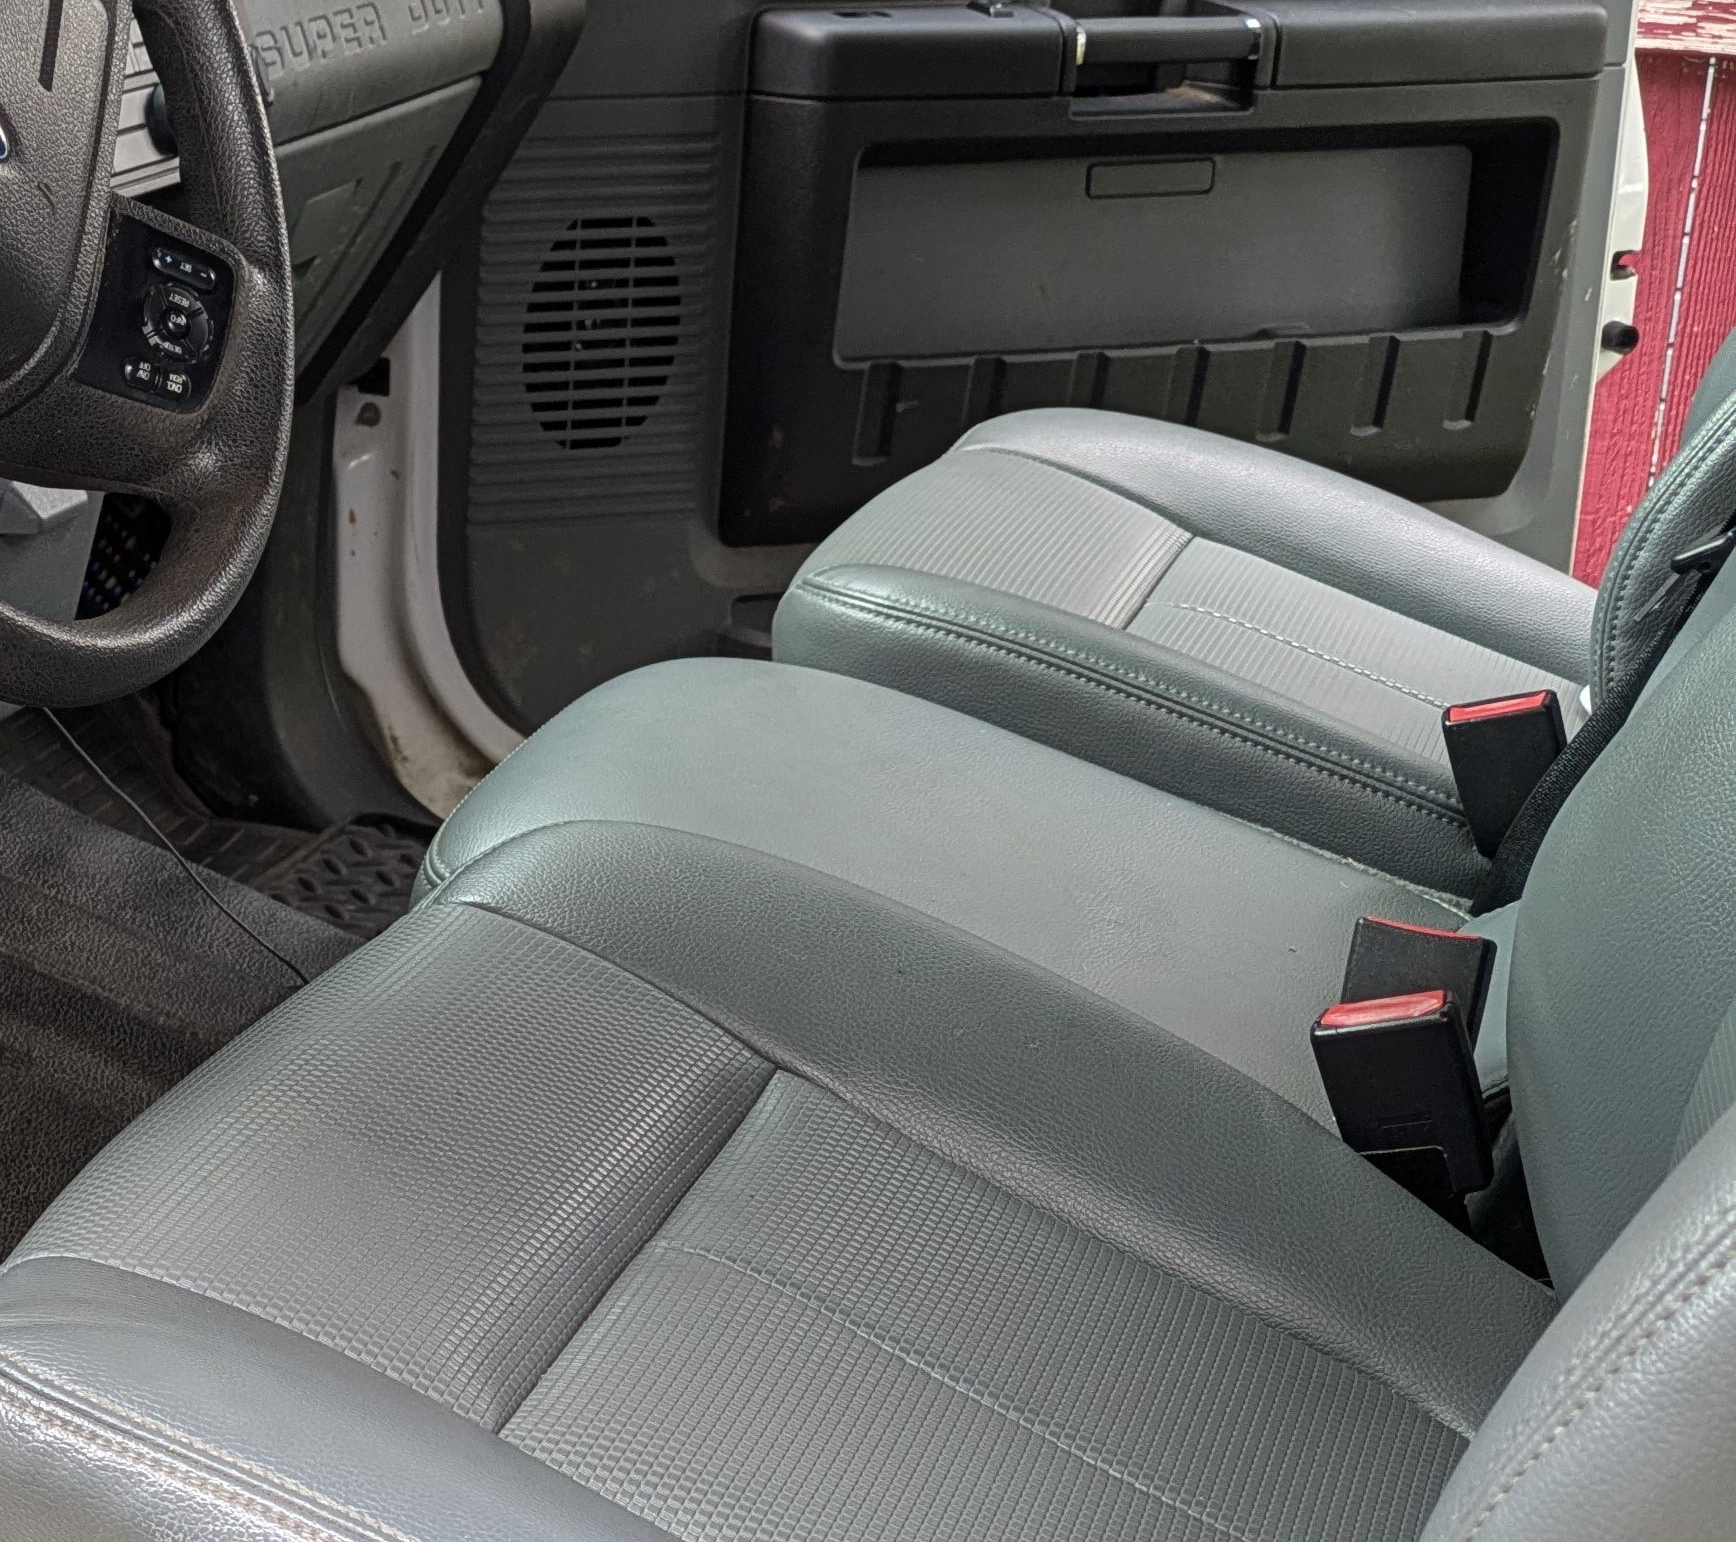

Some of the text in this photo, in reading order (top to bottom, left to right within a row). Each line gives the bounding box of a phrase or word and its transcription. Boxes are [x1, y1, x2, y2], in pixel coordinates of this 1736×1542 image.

[253, 2, 387, 76] SUPER
[179, 261, 192, 273] SET
[169, 292, 189, 308] RESET
